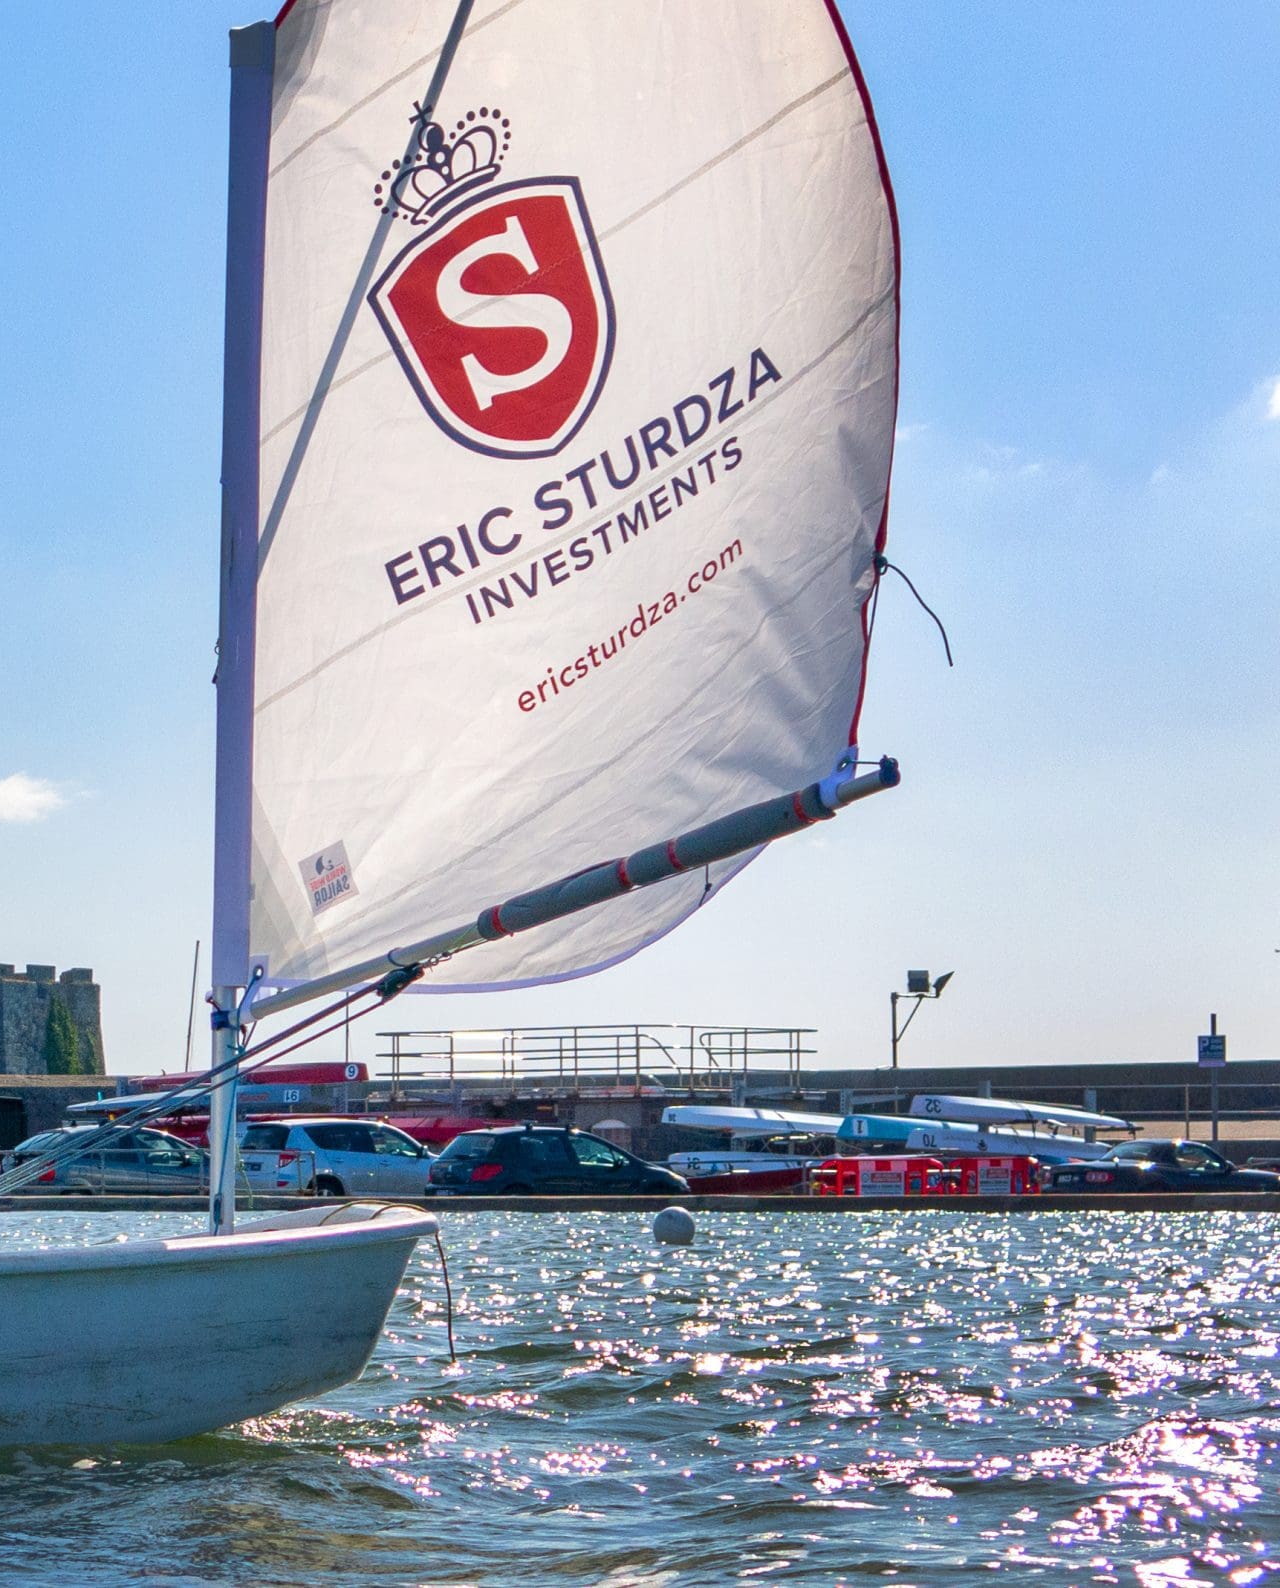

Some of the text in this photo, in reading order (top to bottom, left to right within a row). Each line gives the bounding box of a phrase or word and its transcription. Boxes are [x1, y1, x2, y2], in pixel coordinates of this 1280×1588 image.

[435, 215, 573, 412] S
[384, 347, 783, 606] ERIC STURDZA
[465, 437, 743, 625] INVESTMENTS
[517, 537, 743, 713] ericsturdza.com
